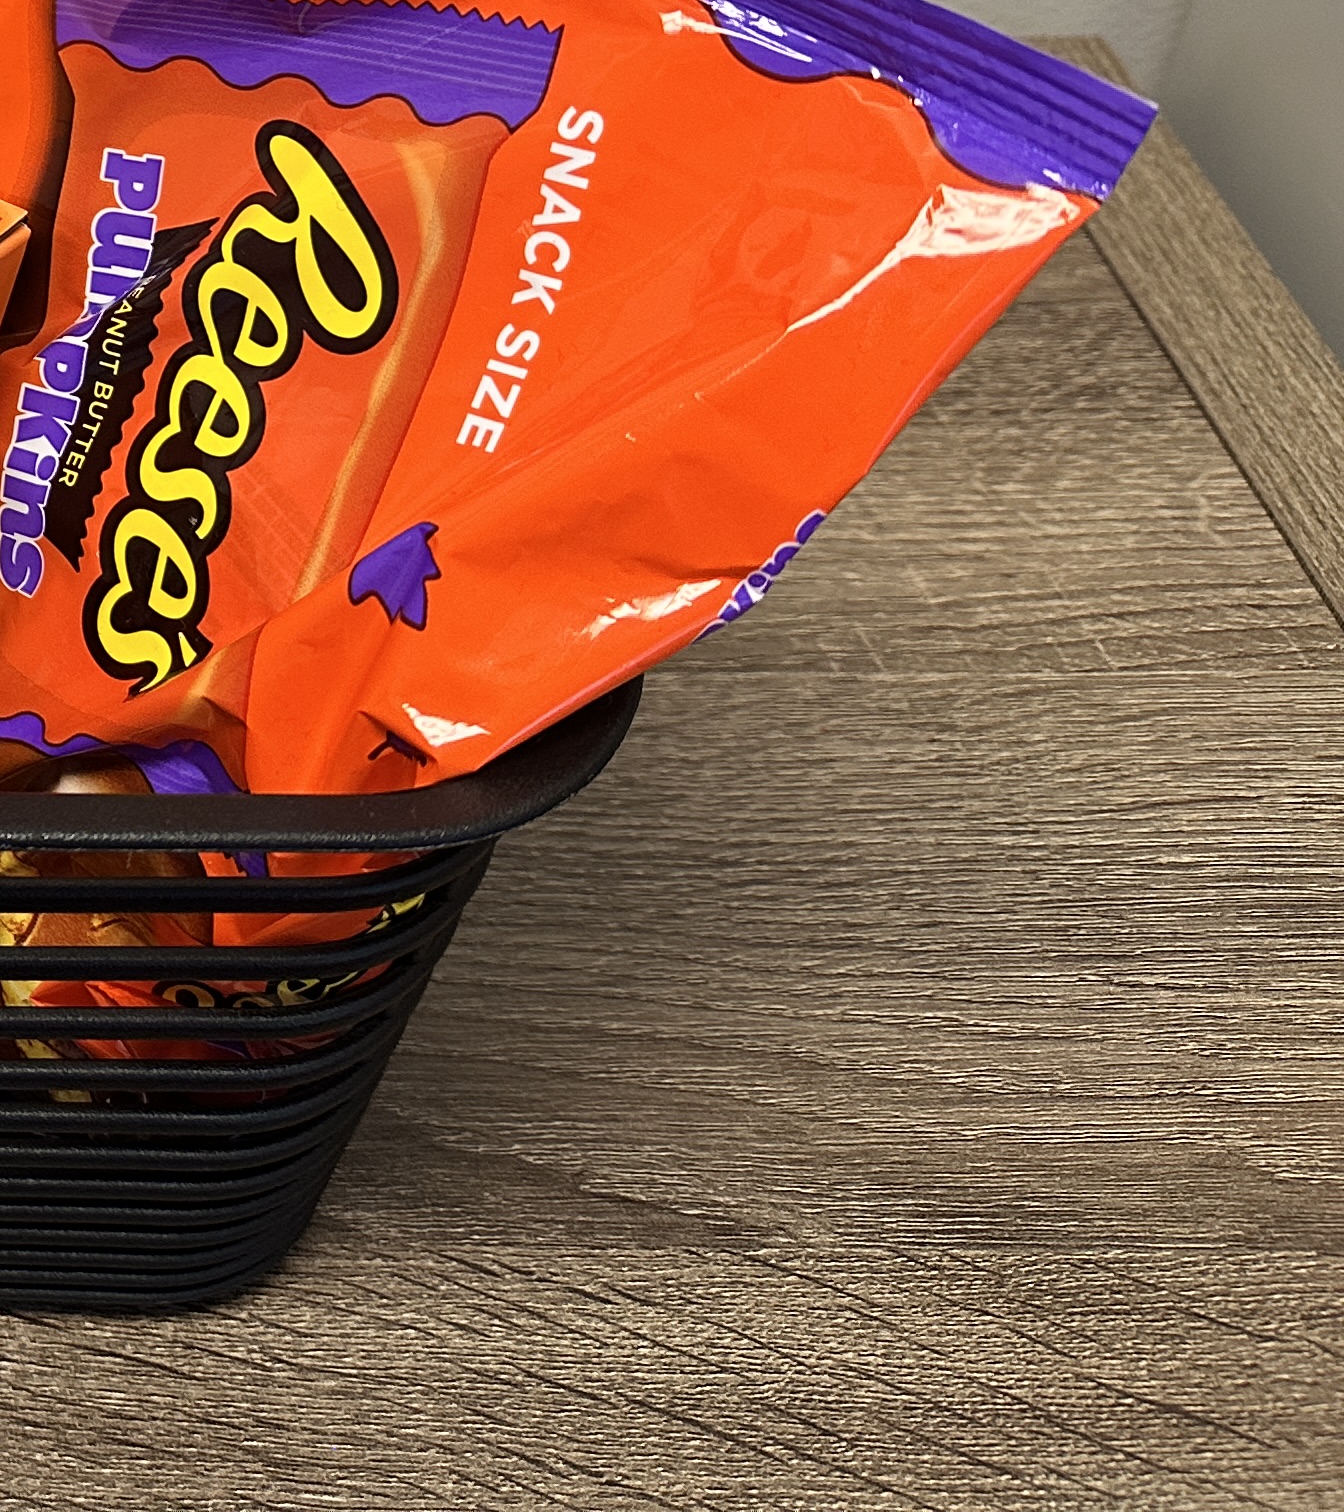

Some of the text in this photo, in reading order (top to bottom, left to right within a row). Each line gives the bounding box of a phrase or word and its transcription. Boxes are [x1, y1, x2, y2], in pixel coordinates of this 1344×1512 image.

[58, 276, 156, 488] EANUT BUTTER
[95, 132, 384, 693] Reese's
[455, 105, 605, 454] SNACK SIZE
